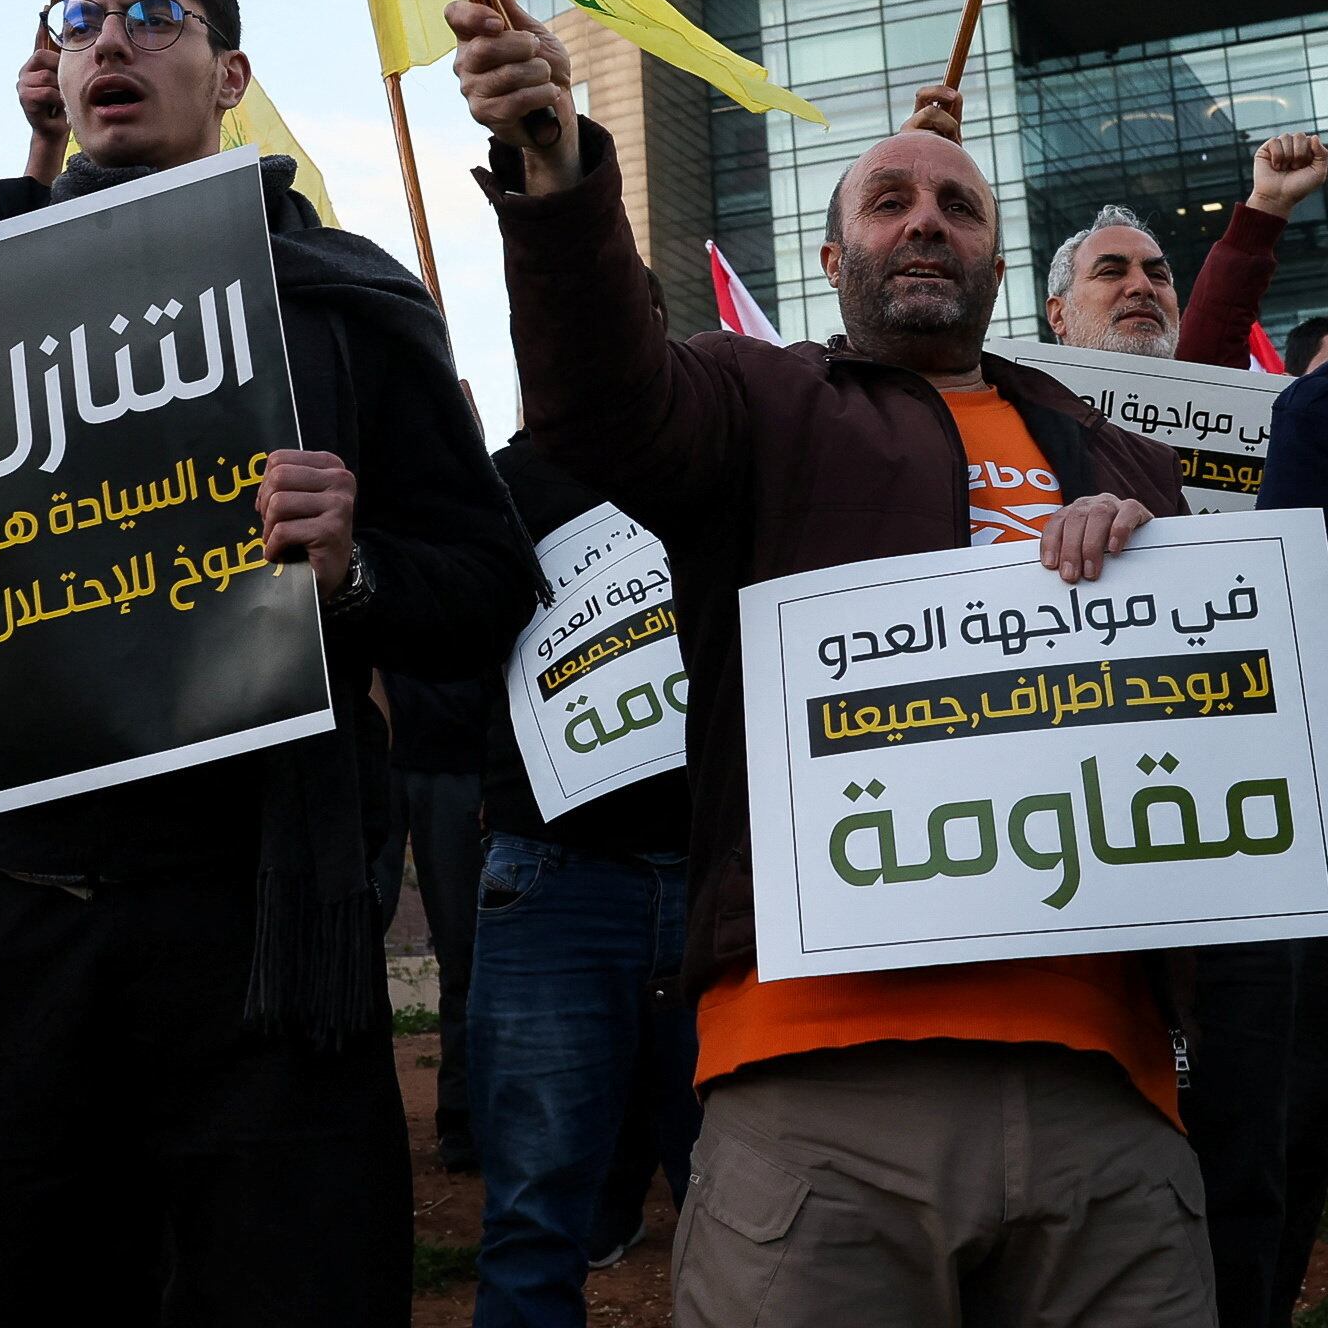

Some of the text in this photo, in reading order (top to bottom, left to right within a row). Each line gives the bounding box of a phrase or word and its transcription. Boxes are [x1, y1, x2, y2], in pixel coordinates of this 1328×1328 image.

[1121, 392, 1234, 441] مواجهة
[1239, 425, 1271, 452] ي
[48, 458, 198, 536] السيادة
[208, 451, 271, 503] عن
[537, 594, 602, 662] العدو
[817, 573, 1259, 681] في مواجهة العدو
[1125, 669, 1235, 716] يوجد
[1242, 656, 1271, 700] لا
[828, 750, 1296, 911] مقاومة
